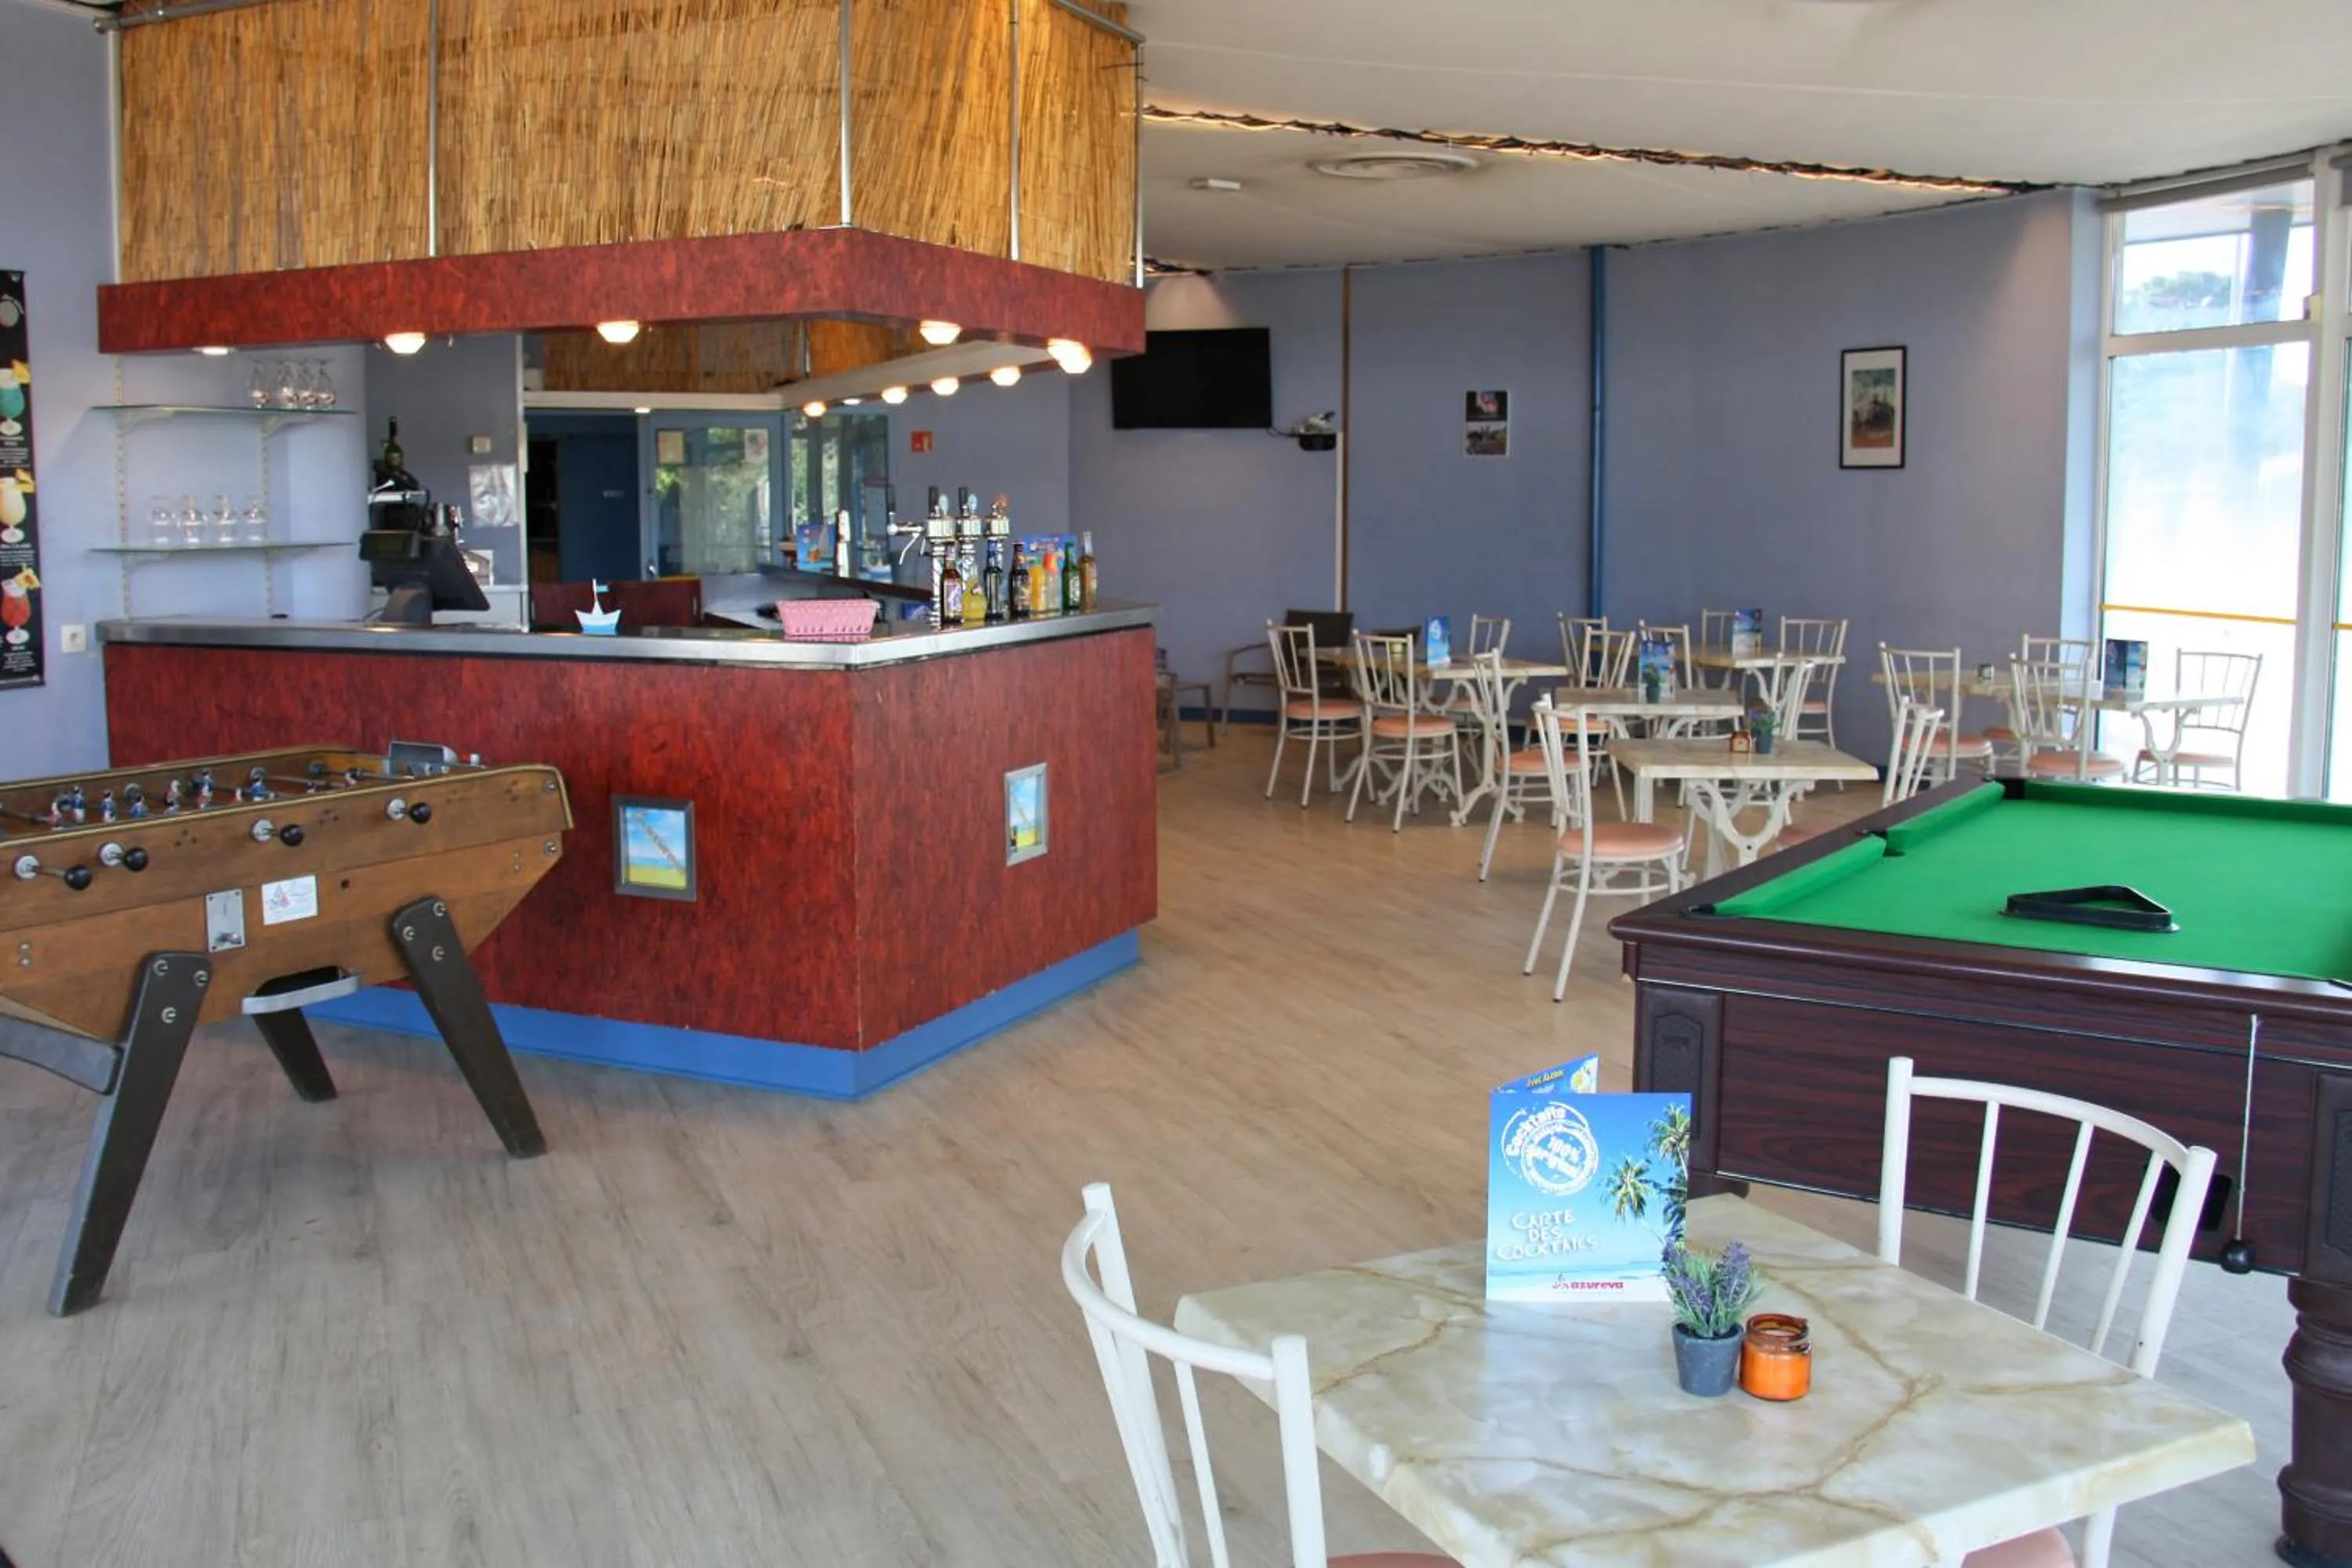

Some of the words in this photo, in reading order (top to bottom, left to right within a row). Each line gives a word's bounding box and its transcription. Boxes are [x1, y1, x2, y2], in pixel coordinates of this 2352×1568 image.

[1511, 1207, 1574, 1229] CARTE
[1528, 1226, 1563, 1243] DES
[1496, 1234, 1597, 1261] COCKTAILS
[1570, 1281, 1624, 1290] azureva
